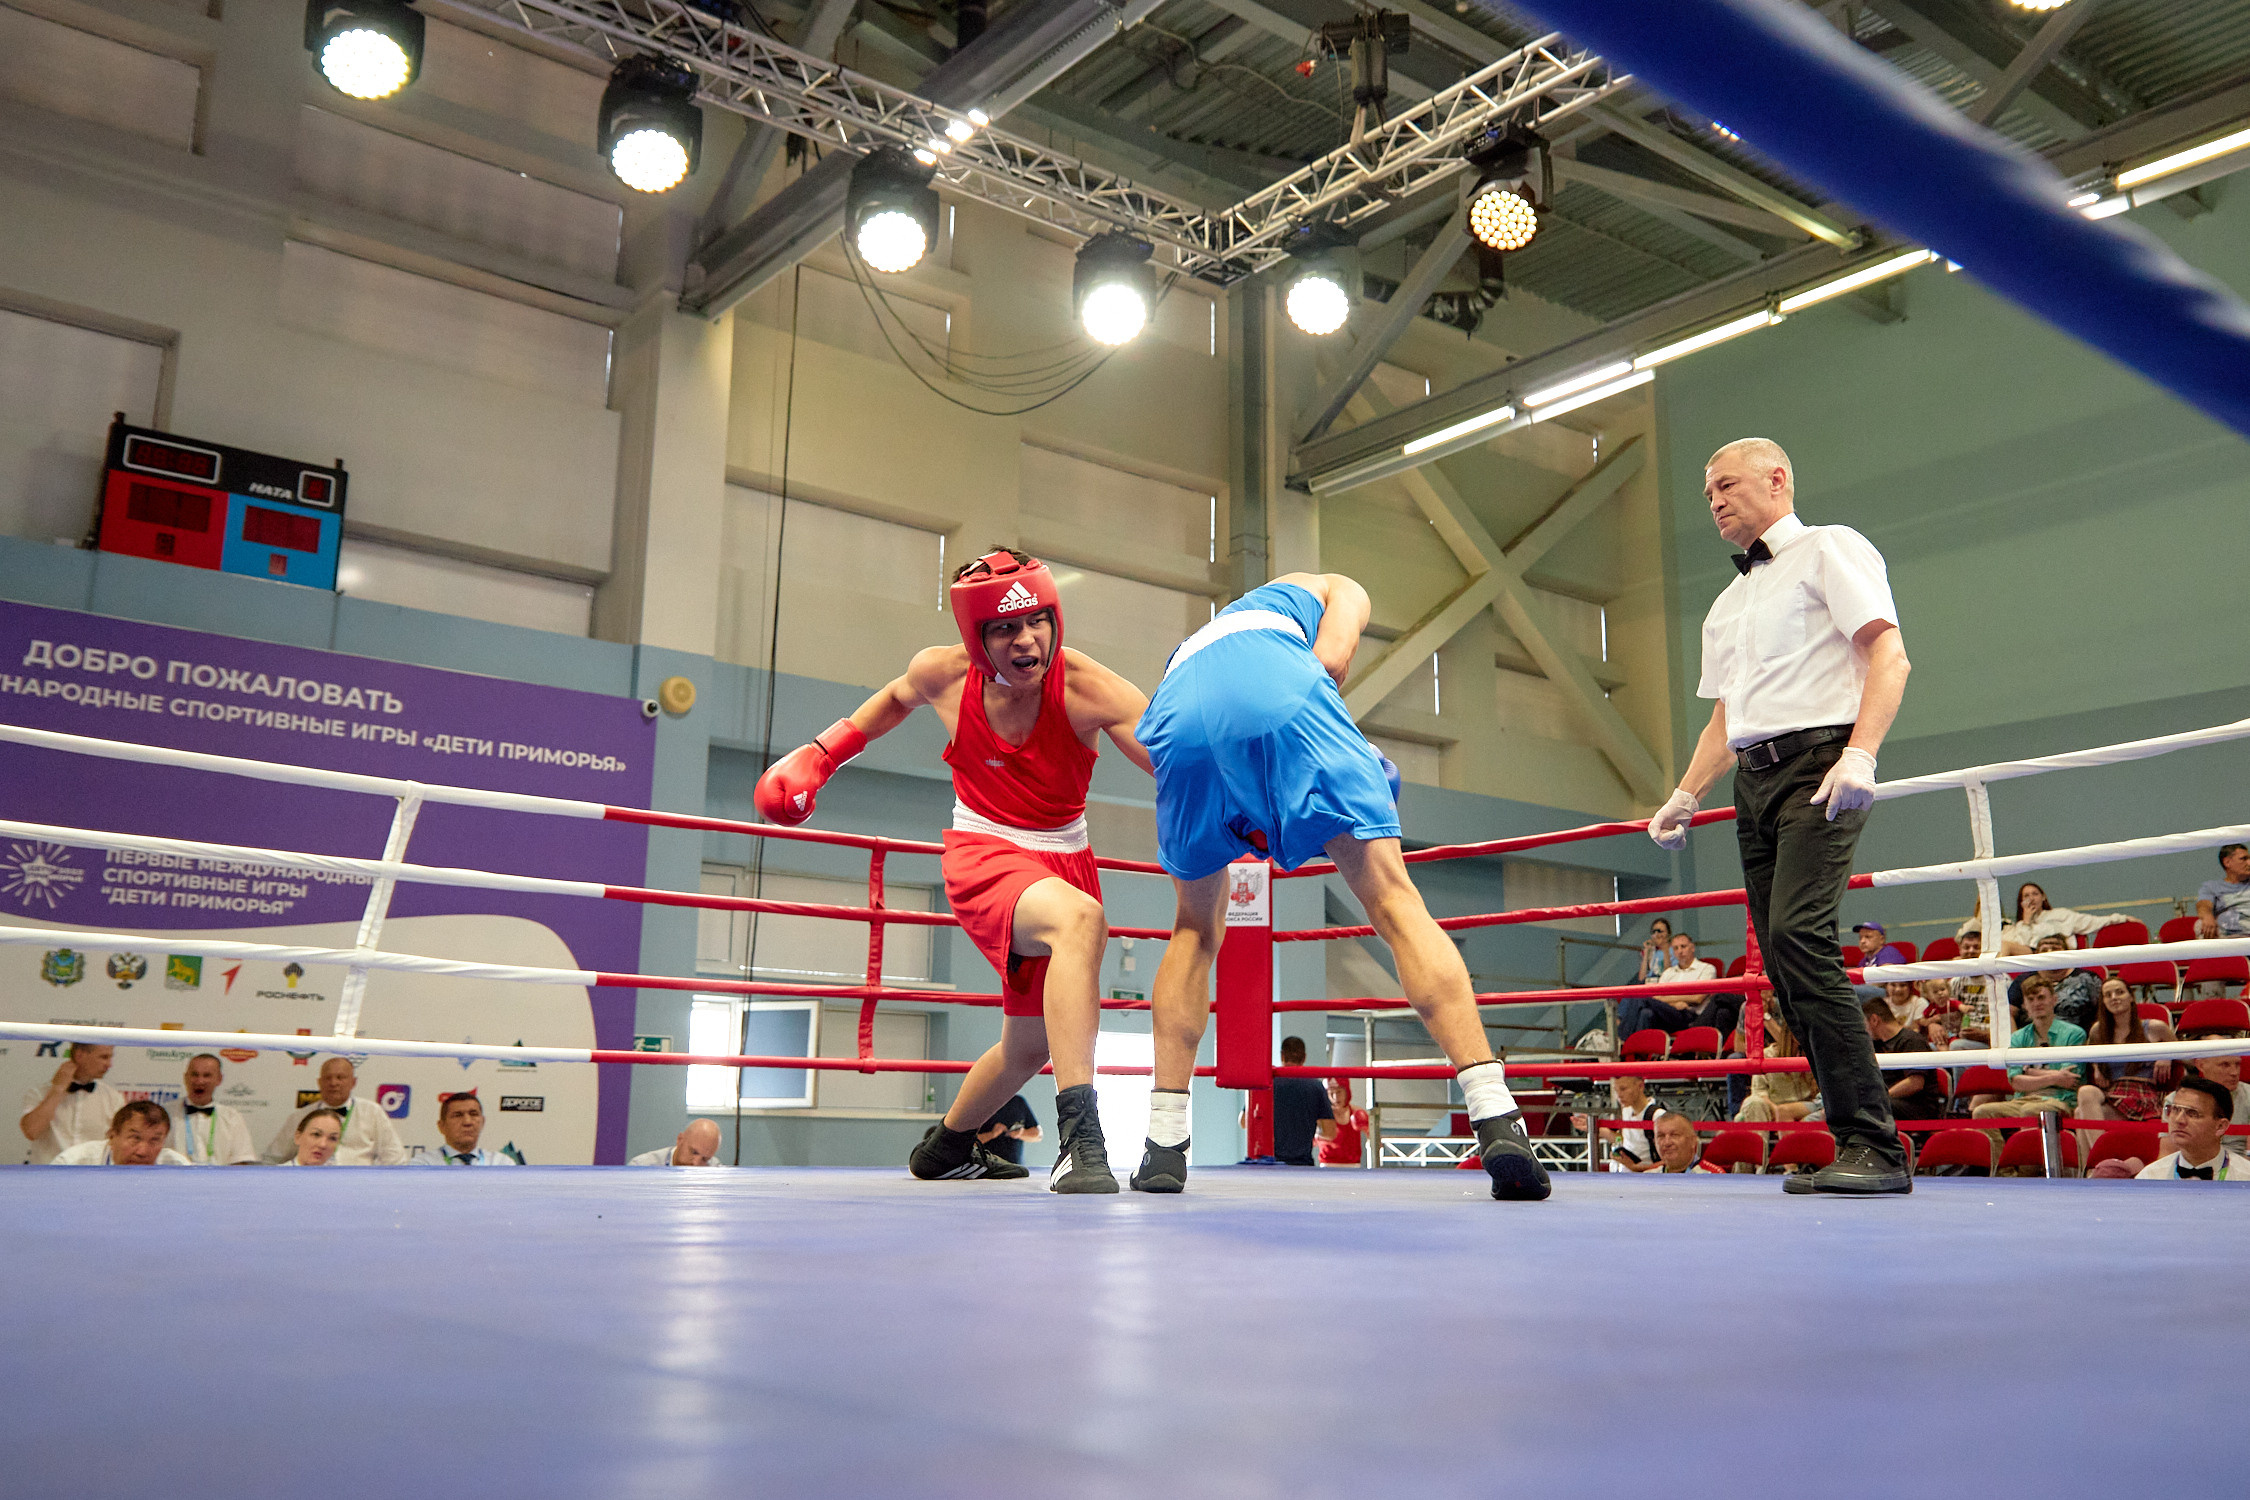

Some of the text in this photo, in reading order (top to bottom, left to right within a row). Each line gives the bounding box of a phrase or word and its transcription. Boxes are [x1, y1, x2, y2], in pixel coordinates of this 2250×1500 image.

[997, 598, 1039, 613] adidas
[23, 639, 404, 715] ДОБРО ПОЖАЛОВАТЬ
[0, 674, 627, 772] НАРОДНЫЕ СПОРТИВНЫЕ ИГРЫ «ДЕТИ ПРИМОРЬЯ»
[102, 867, 248, 894] СПОРТИВНЫЕ
[252, 880, 308, 899] ИГРЫ
[105, 849, 374, 885] ПЕРВЫЕ МЕЖДУНАРОДНЫ
[256, 989, 326, 1001] РОСНЕФТЬ
